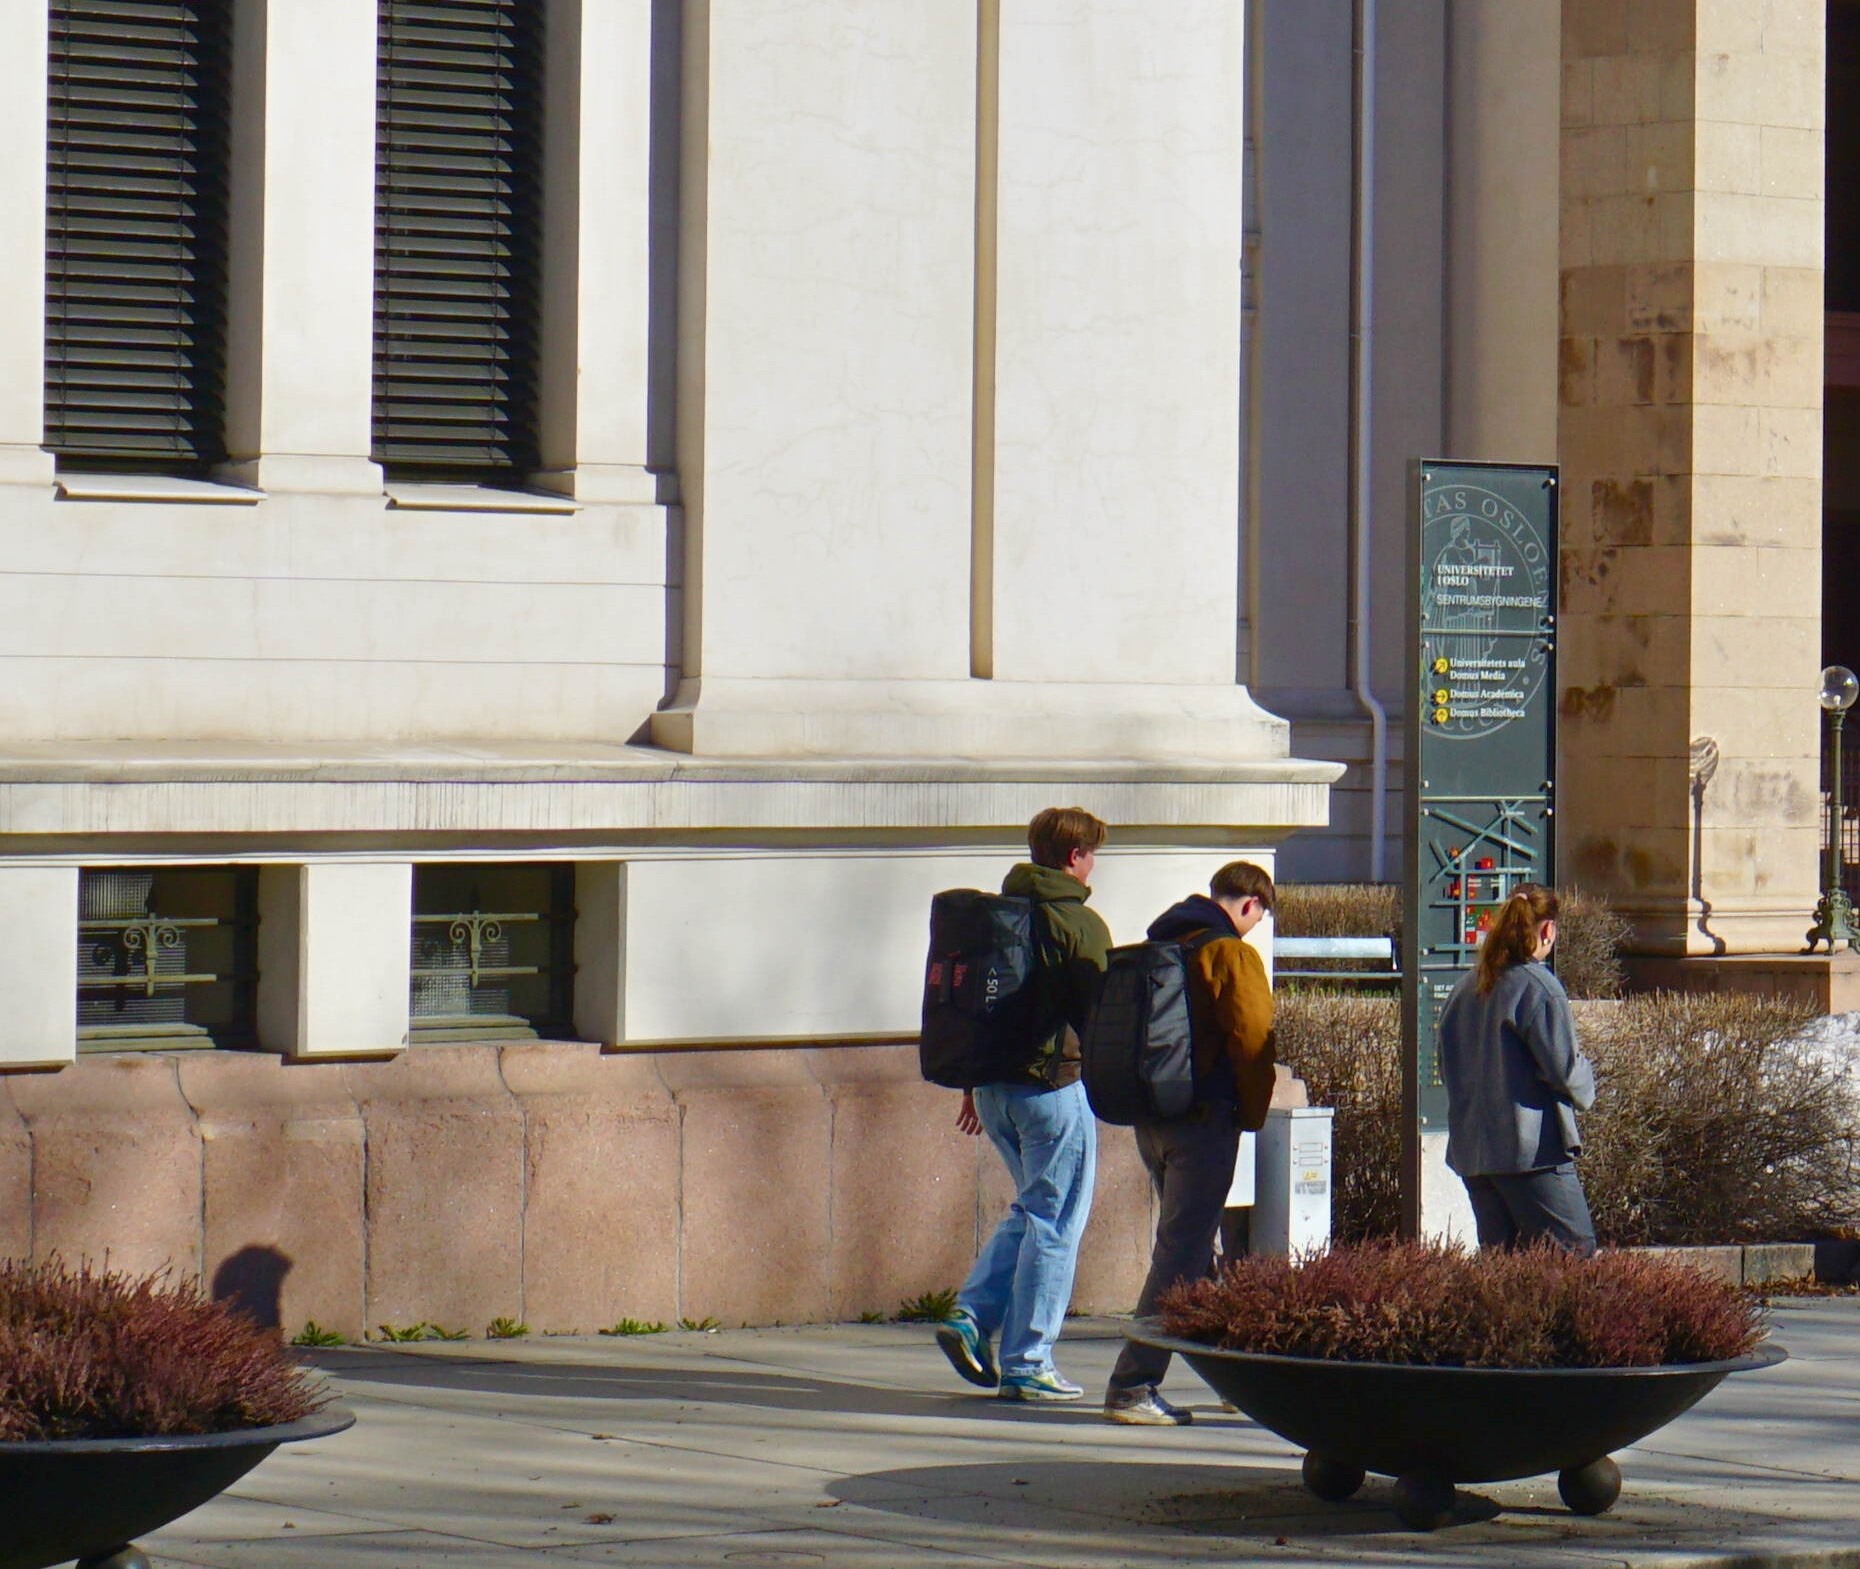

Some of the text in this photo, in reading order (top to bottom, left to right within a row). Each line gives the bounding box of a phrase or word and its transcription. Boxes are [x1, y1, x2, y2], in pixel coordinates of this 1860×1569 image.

[1437, 564, 1514, 576] UNIVERSITETET
[1442, 576, 1469, 586] OSLO
[1436, 594, 1542, 607] SENTRUMSBYGNINGENE
[1449, 658, 1526, 668] Universitetets aula
[1449, 670, 1506, 680] Domus Media
[1449, 689, 1479, 699] Domus
[1449, 707, 1526, 717] Domus Bibliotheca
